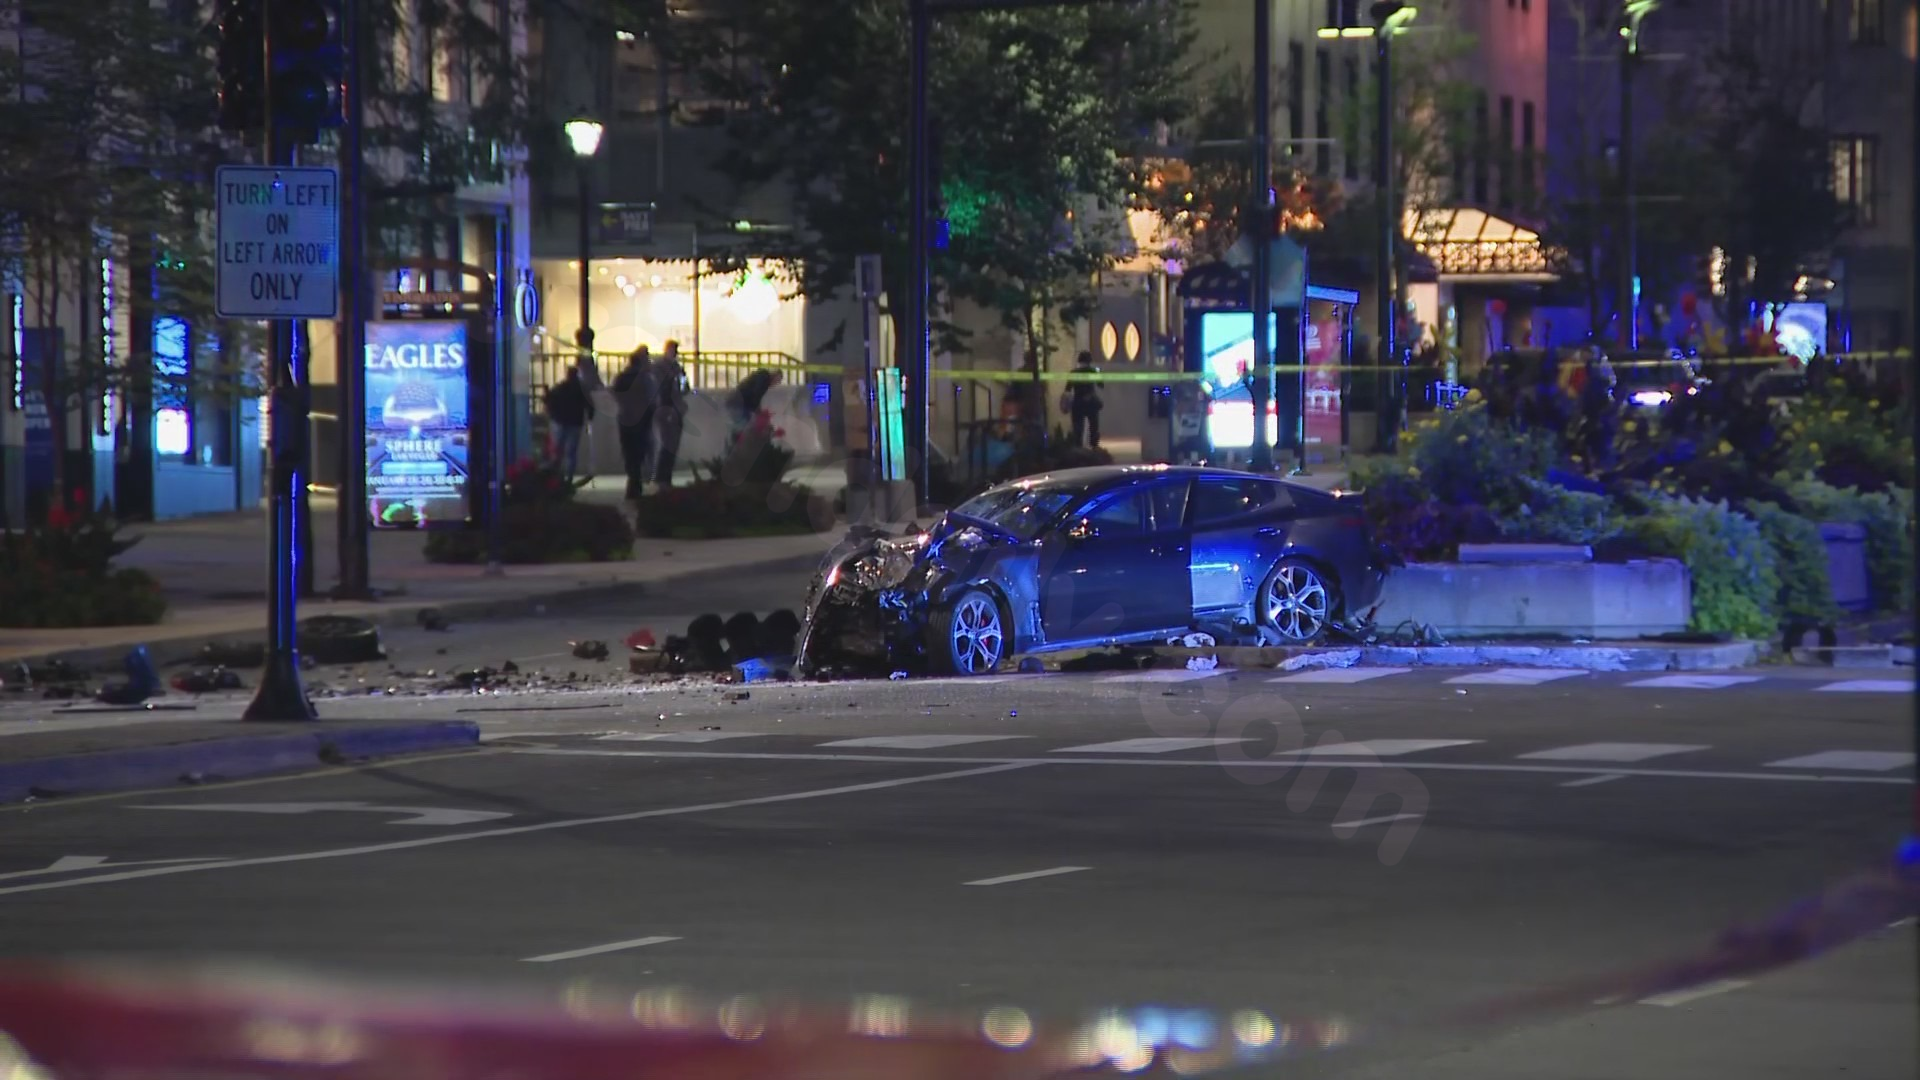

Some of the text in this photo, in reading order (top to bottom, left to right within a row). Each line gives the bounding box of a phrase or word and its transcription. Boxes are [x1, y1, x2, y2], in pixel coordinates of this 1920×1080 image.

[224, 183, 330, 206] TURN LEFT
[266, 213, 288, 235] ON
[224, 242, 329, 264] LEFT ARROW
[251, 272, 303, 301] ONLY
[364, 343, 464, 368] EAGLES
[385, 440, 442, 453] SPHERE
